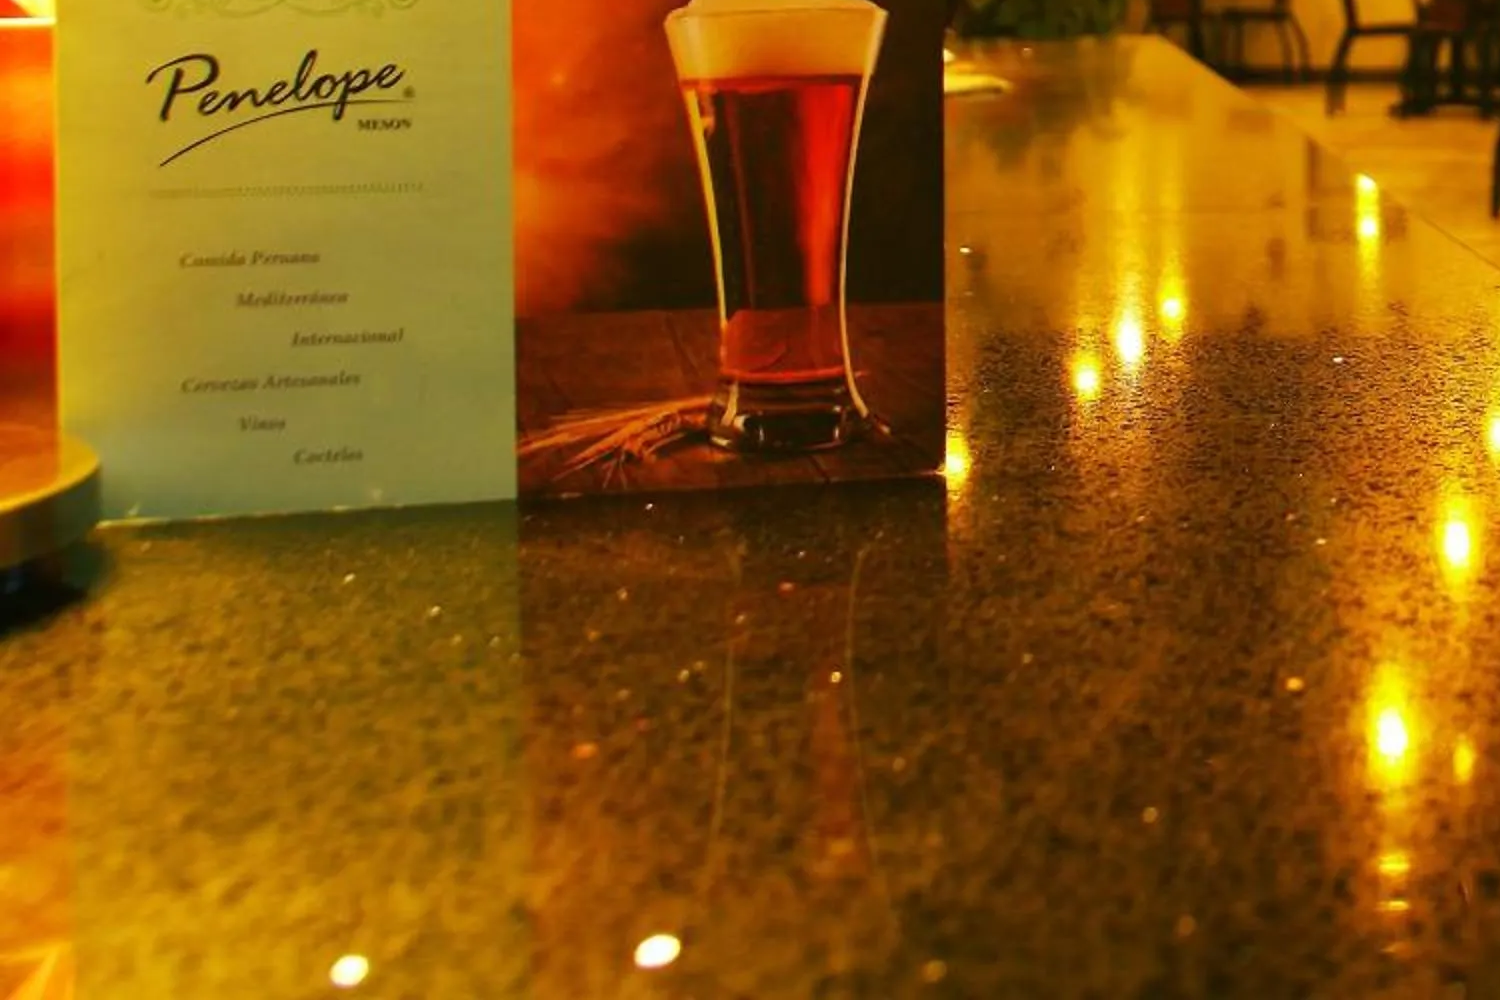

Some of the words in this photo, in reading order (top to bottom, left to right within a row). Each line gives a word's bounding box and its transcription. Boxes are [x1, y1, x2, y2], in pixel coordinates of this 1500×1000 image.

[146, 50, 404, 121] Penelope
[179, 250, 246, 268] Comida
[251, 250, 320, 266] Peruana
[291, 327, 404, 346] Internacional
[180, 377, 258, 394] Cervezas
[261, 369, 361, 389] Artesanales
[238, 416, 287, 432] Vinos
